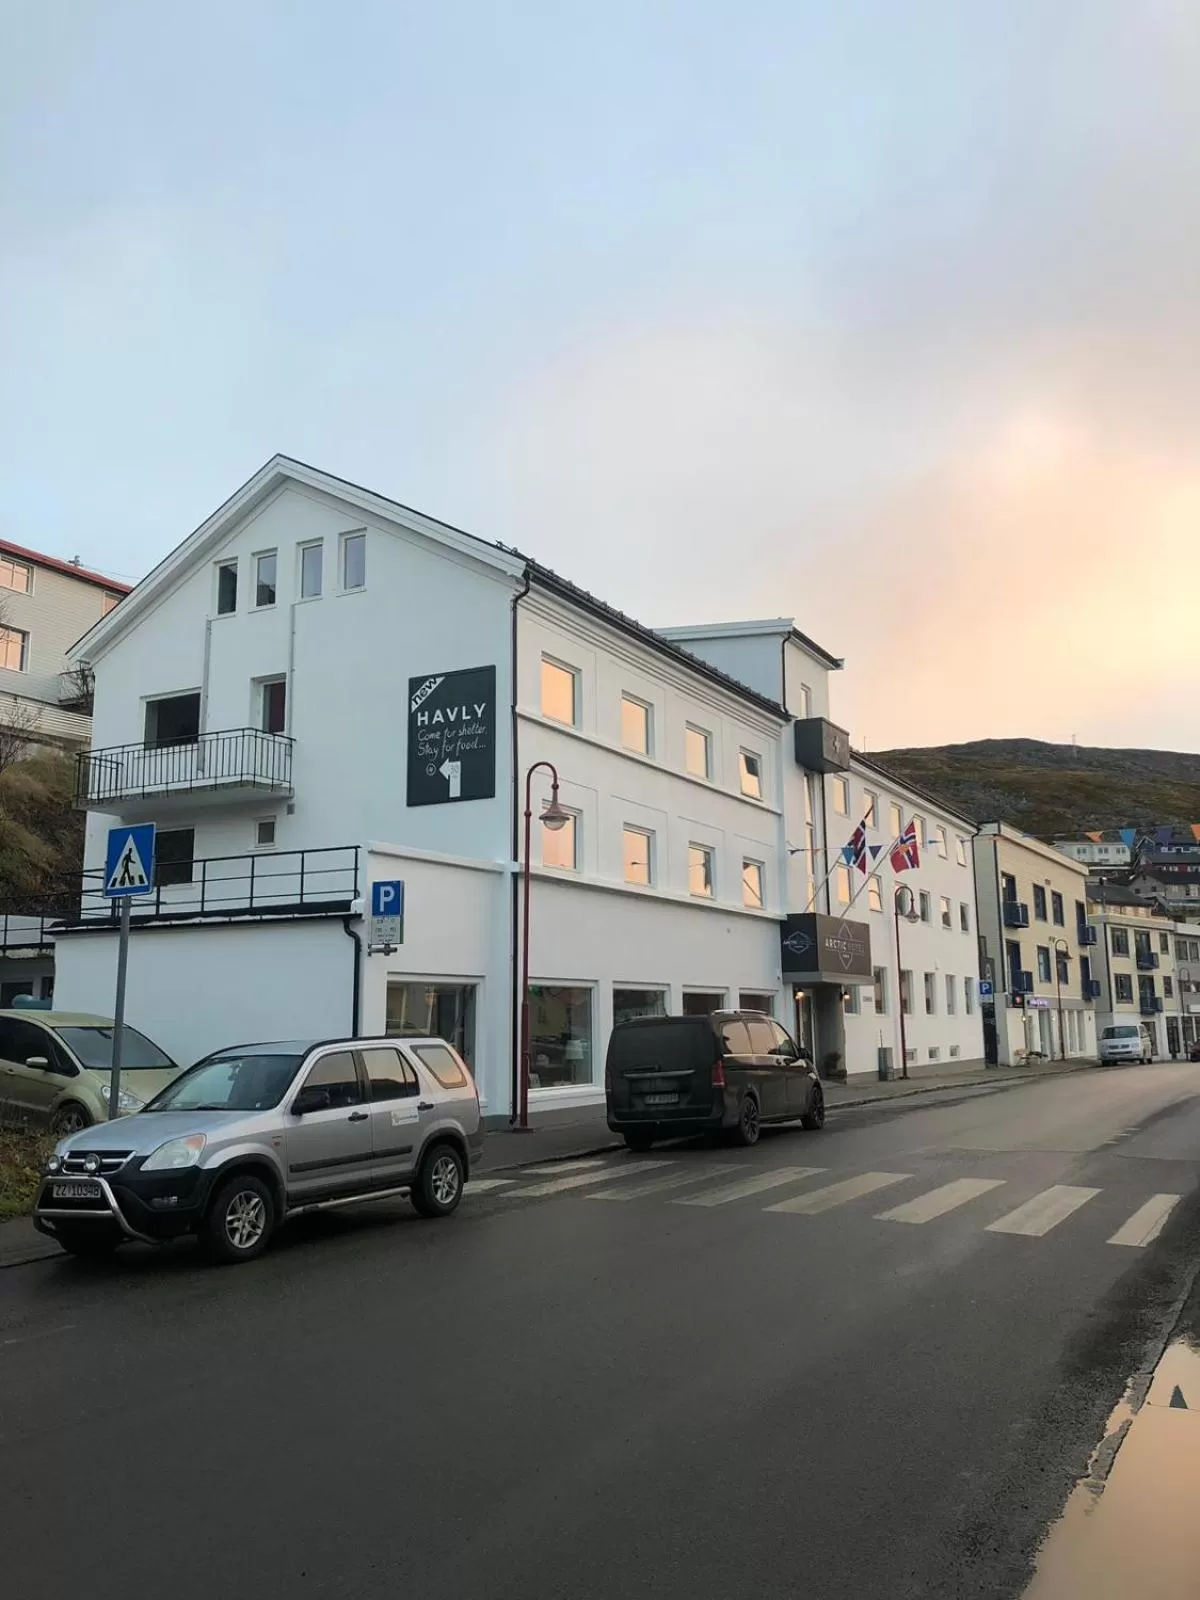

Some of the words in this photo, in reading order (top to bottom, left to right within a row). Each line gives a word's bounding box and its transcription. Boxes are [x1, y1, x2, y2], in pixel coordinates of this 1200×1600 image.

[412, 677, 437, 705] new
[417, 703, 487, 726] HAVLY
[417, 729, 441, 741] Come
[417, 742, 439, 761] Stay
[442, 742, 455, 758] for
[380, 886, 395, 912] P
[825, 938, 847, 951] ARCTIC
[982, 983, 990, 993] P
